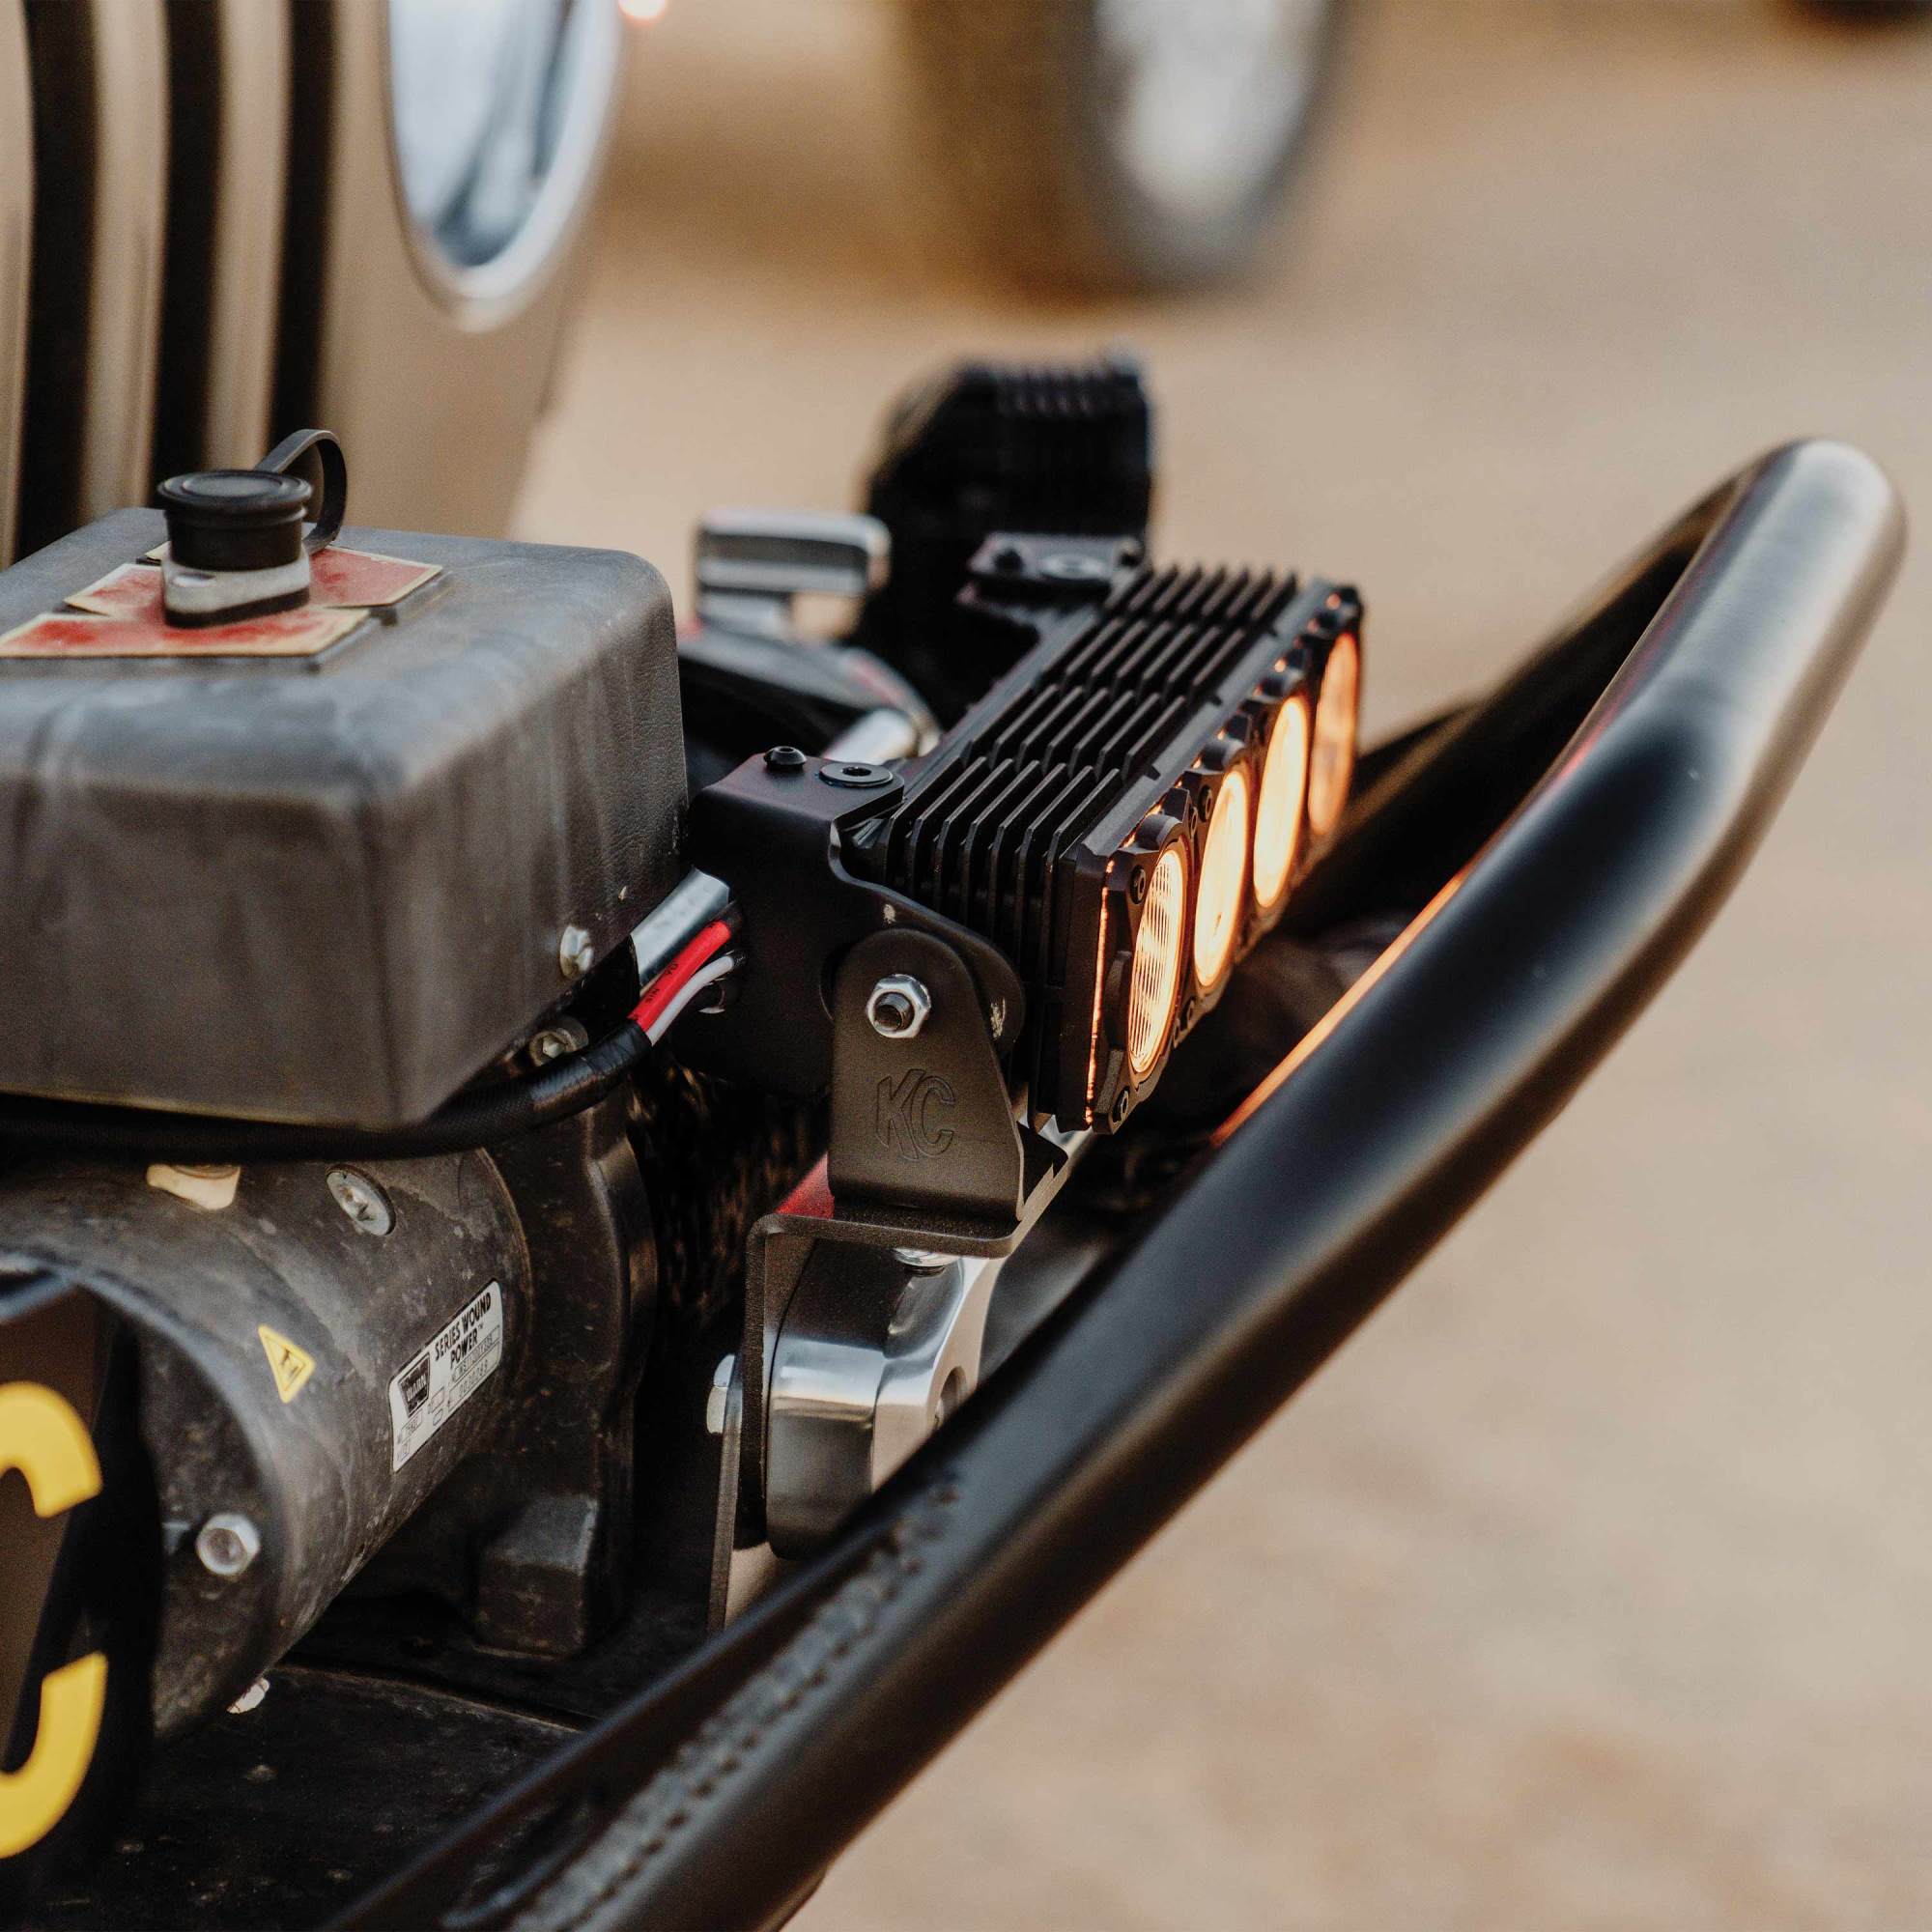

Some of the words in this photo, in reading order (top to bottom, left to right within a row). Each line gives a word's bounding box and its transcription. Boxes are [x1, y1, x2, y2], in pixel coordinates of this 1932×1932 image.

[874, 1068, 955, 1160] KC
[436, 1321, 461, 1362] SERIES
[462, 1293, 492, 1334] WOUND
[405, 1373, 428, 1400] WARN
